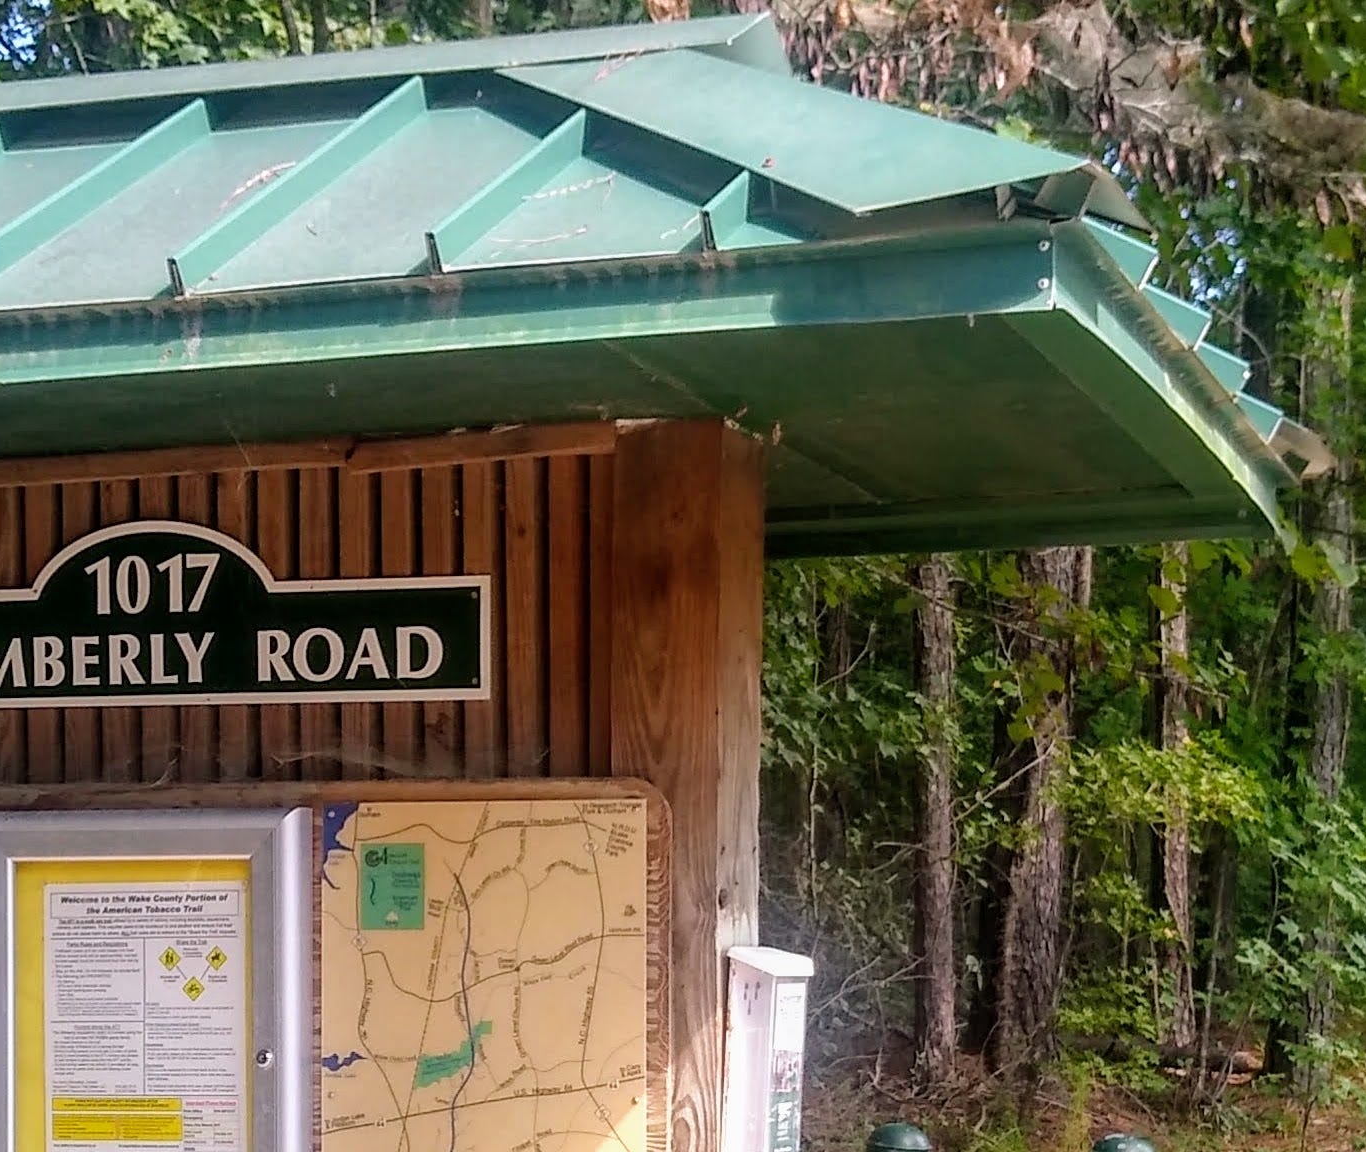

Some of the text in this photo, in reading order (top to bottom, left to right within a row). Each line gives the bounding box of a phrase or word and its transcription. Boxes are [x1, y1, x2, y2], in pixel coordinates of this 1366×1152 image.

[84, 552, 222, 616] 1017
[256, 625, 444, 684] ROAD
[102, 906, 143, 914] American
[145, 905, 181, 913] Tobacco
[153, 894, 183, 903] County
[219, 893, 228, 901] of
